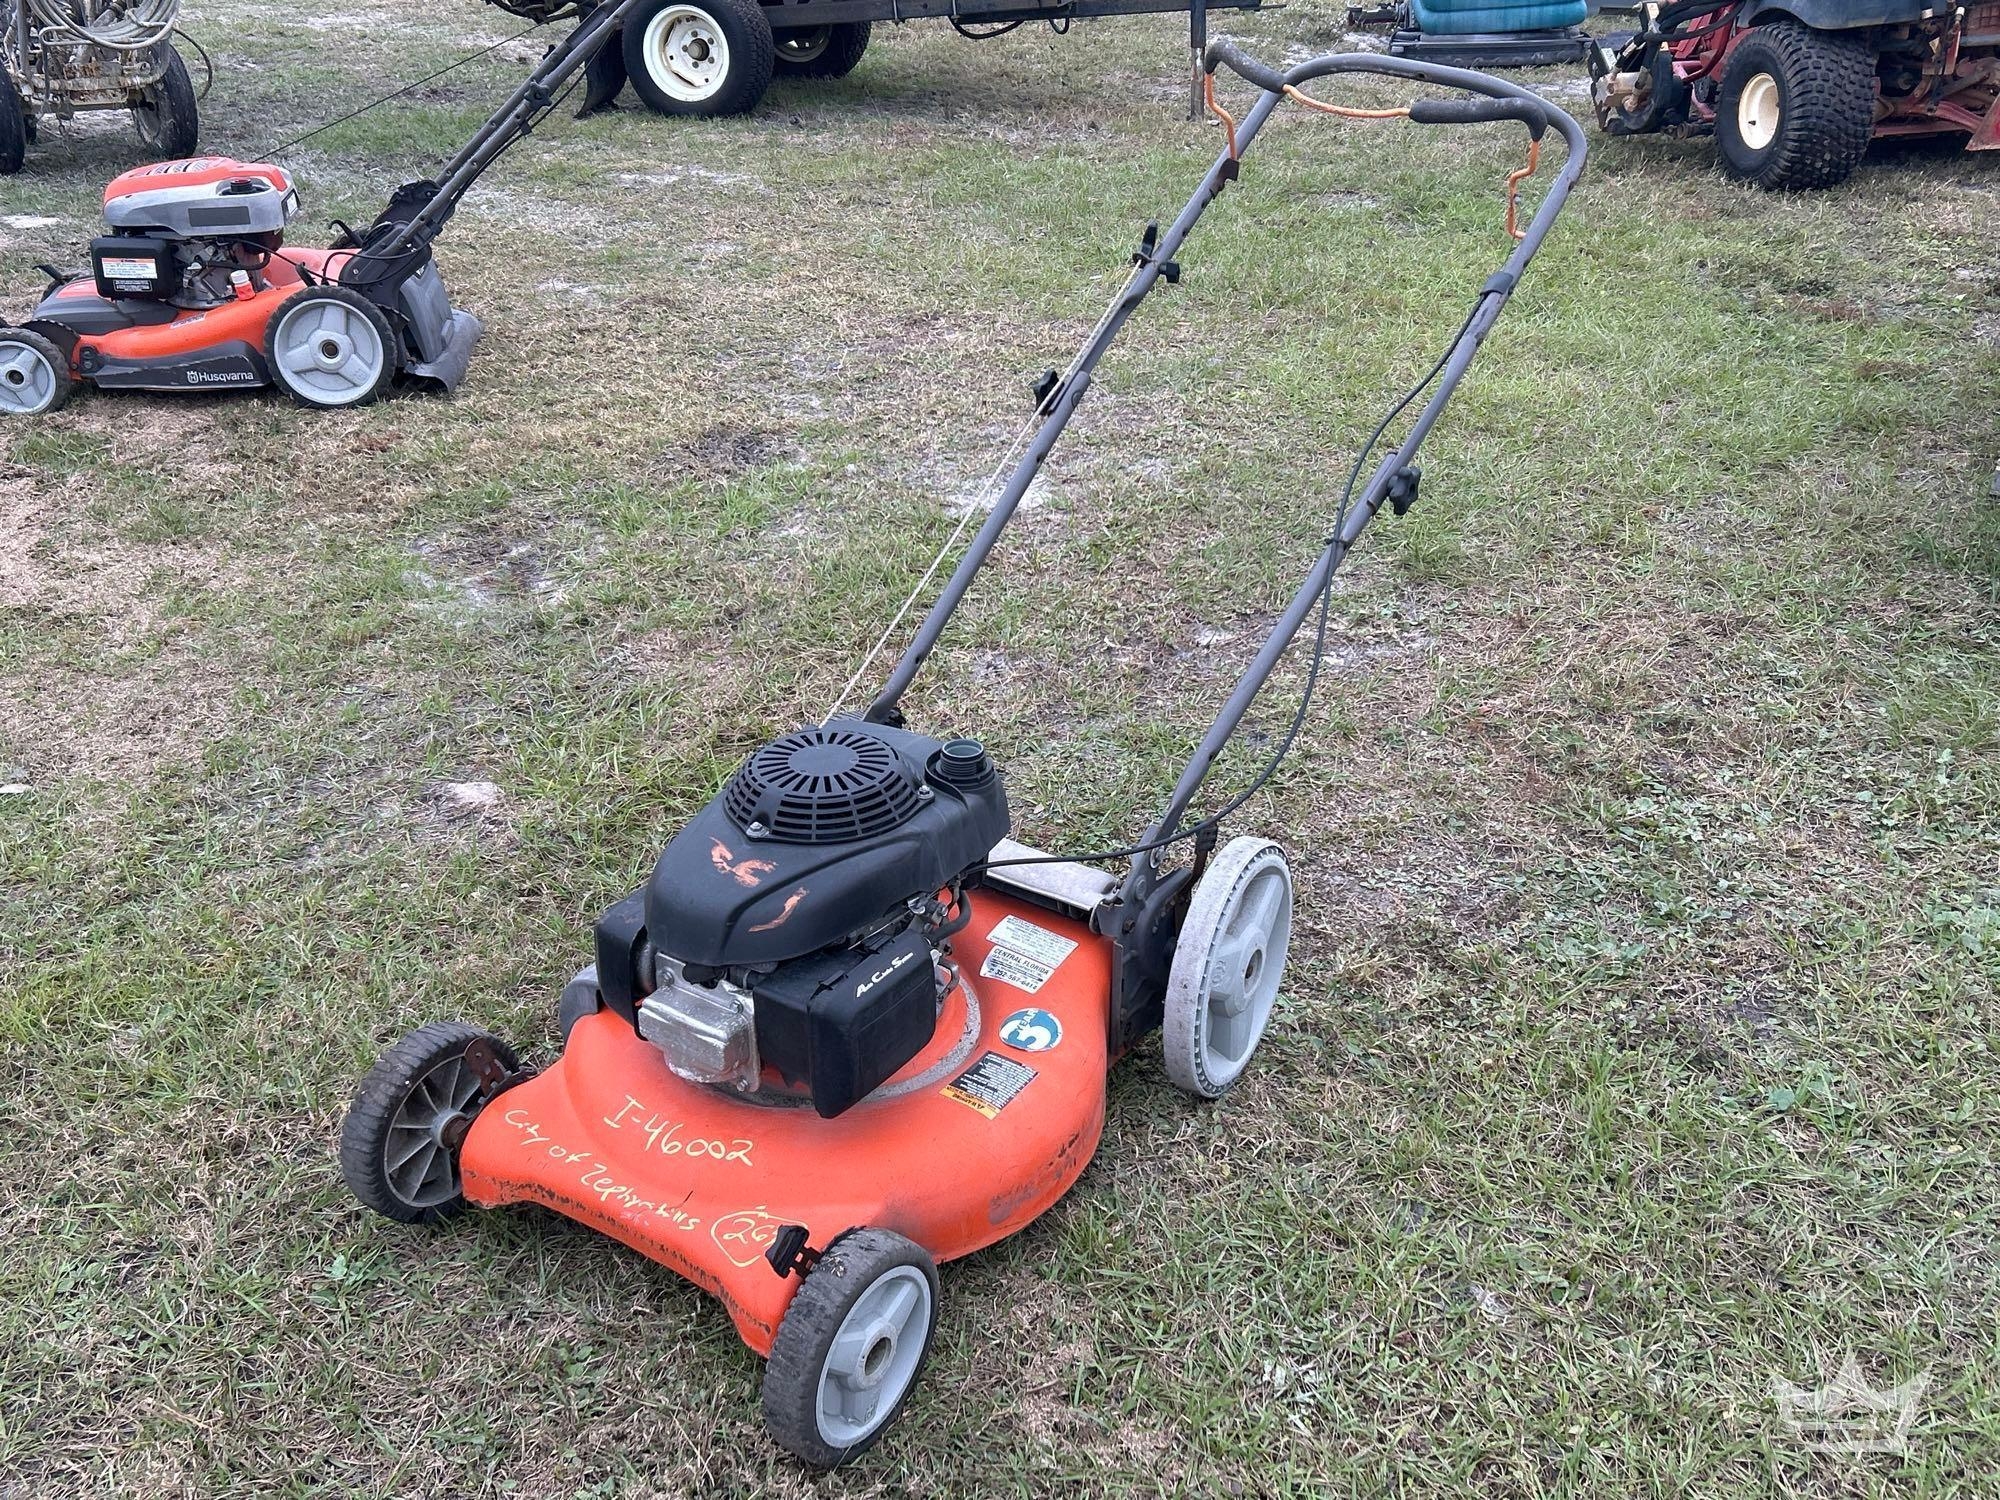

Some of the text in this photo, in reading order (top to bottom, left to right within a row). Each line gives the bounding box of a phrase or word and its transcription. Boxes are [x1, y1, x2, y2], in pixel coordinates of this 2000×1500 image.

[199, 371, 254, 382] Husqvarna
[994, 948, 1022, 963] CENTRAL
[1023, 960, 1050, 975] FLORIDA
[1000, 1019, 1052, 1050] 5
[505, 1109, 550, 1146] City
[549, 1145, 592, 1163] of
[603, 1094, 753, 1166] I-46002
